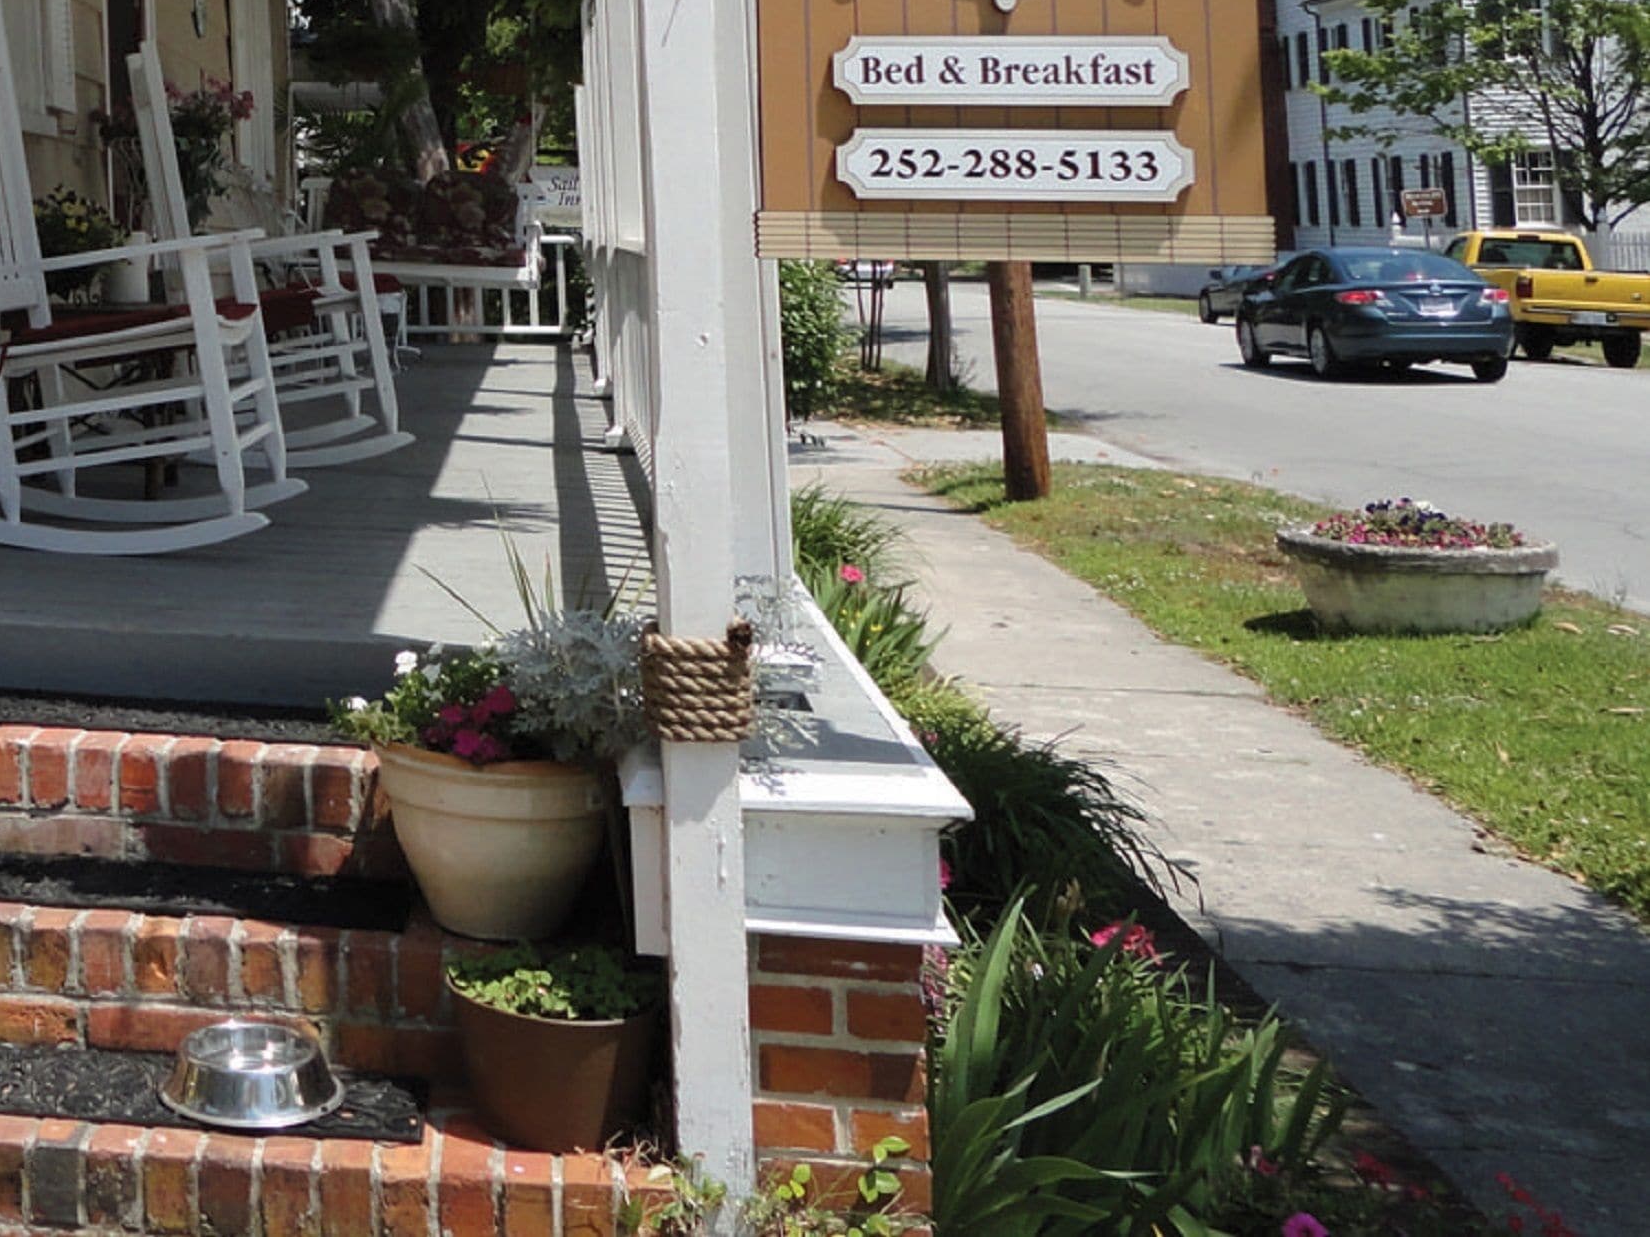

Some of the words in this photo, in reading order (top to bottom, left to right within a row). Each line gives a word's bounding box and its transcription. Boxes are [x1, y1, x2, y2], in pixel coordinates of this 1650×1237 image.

[860, 54, 925, 86] Bed
[938, 56, 966, 86] &
[979, 53, 1157, 87] Breakfast
[869, 148, 1160, 182] 252-288-5133
